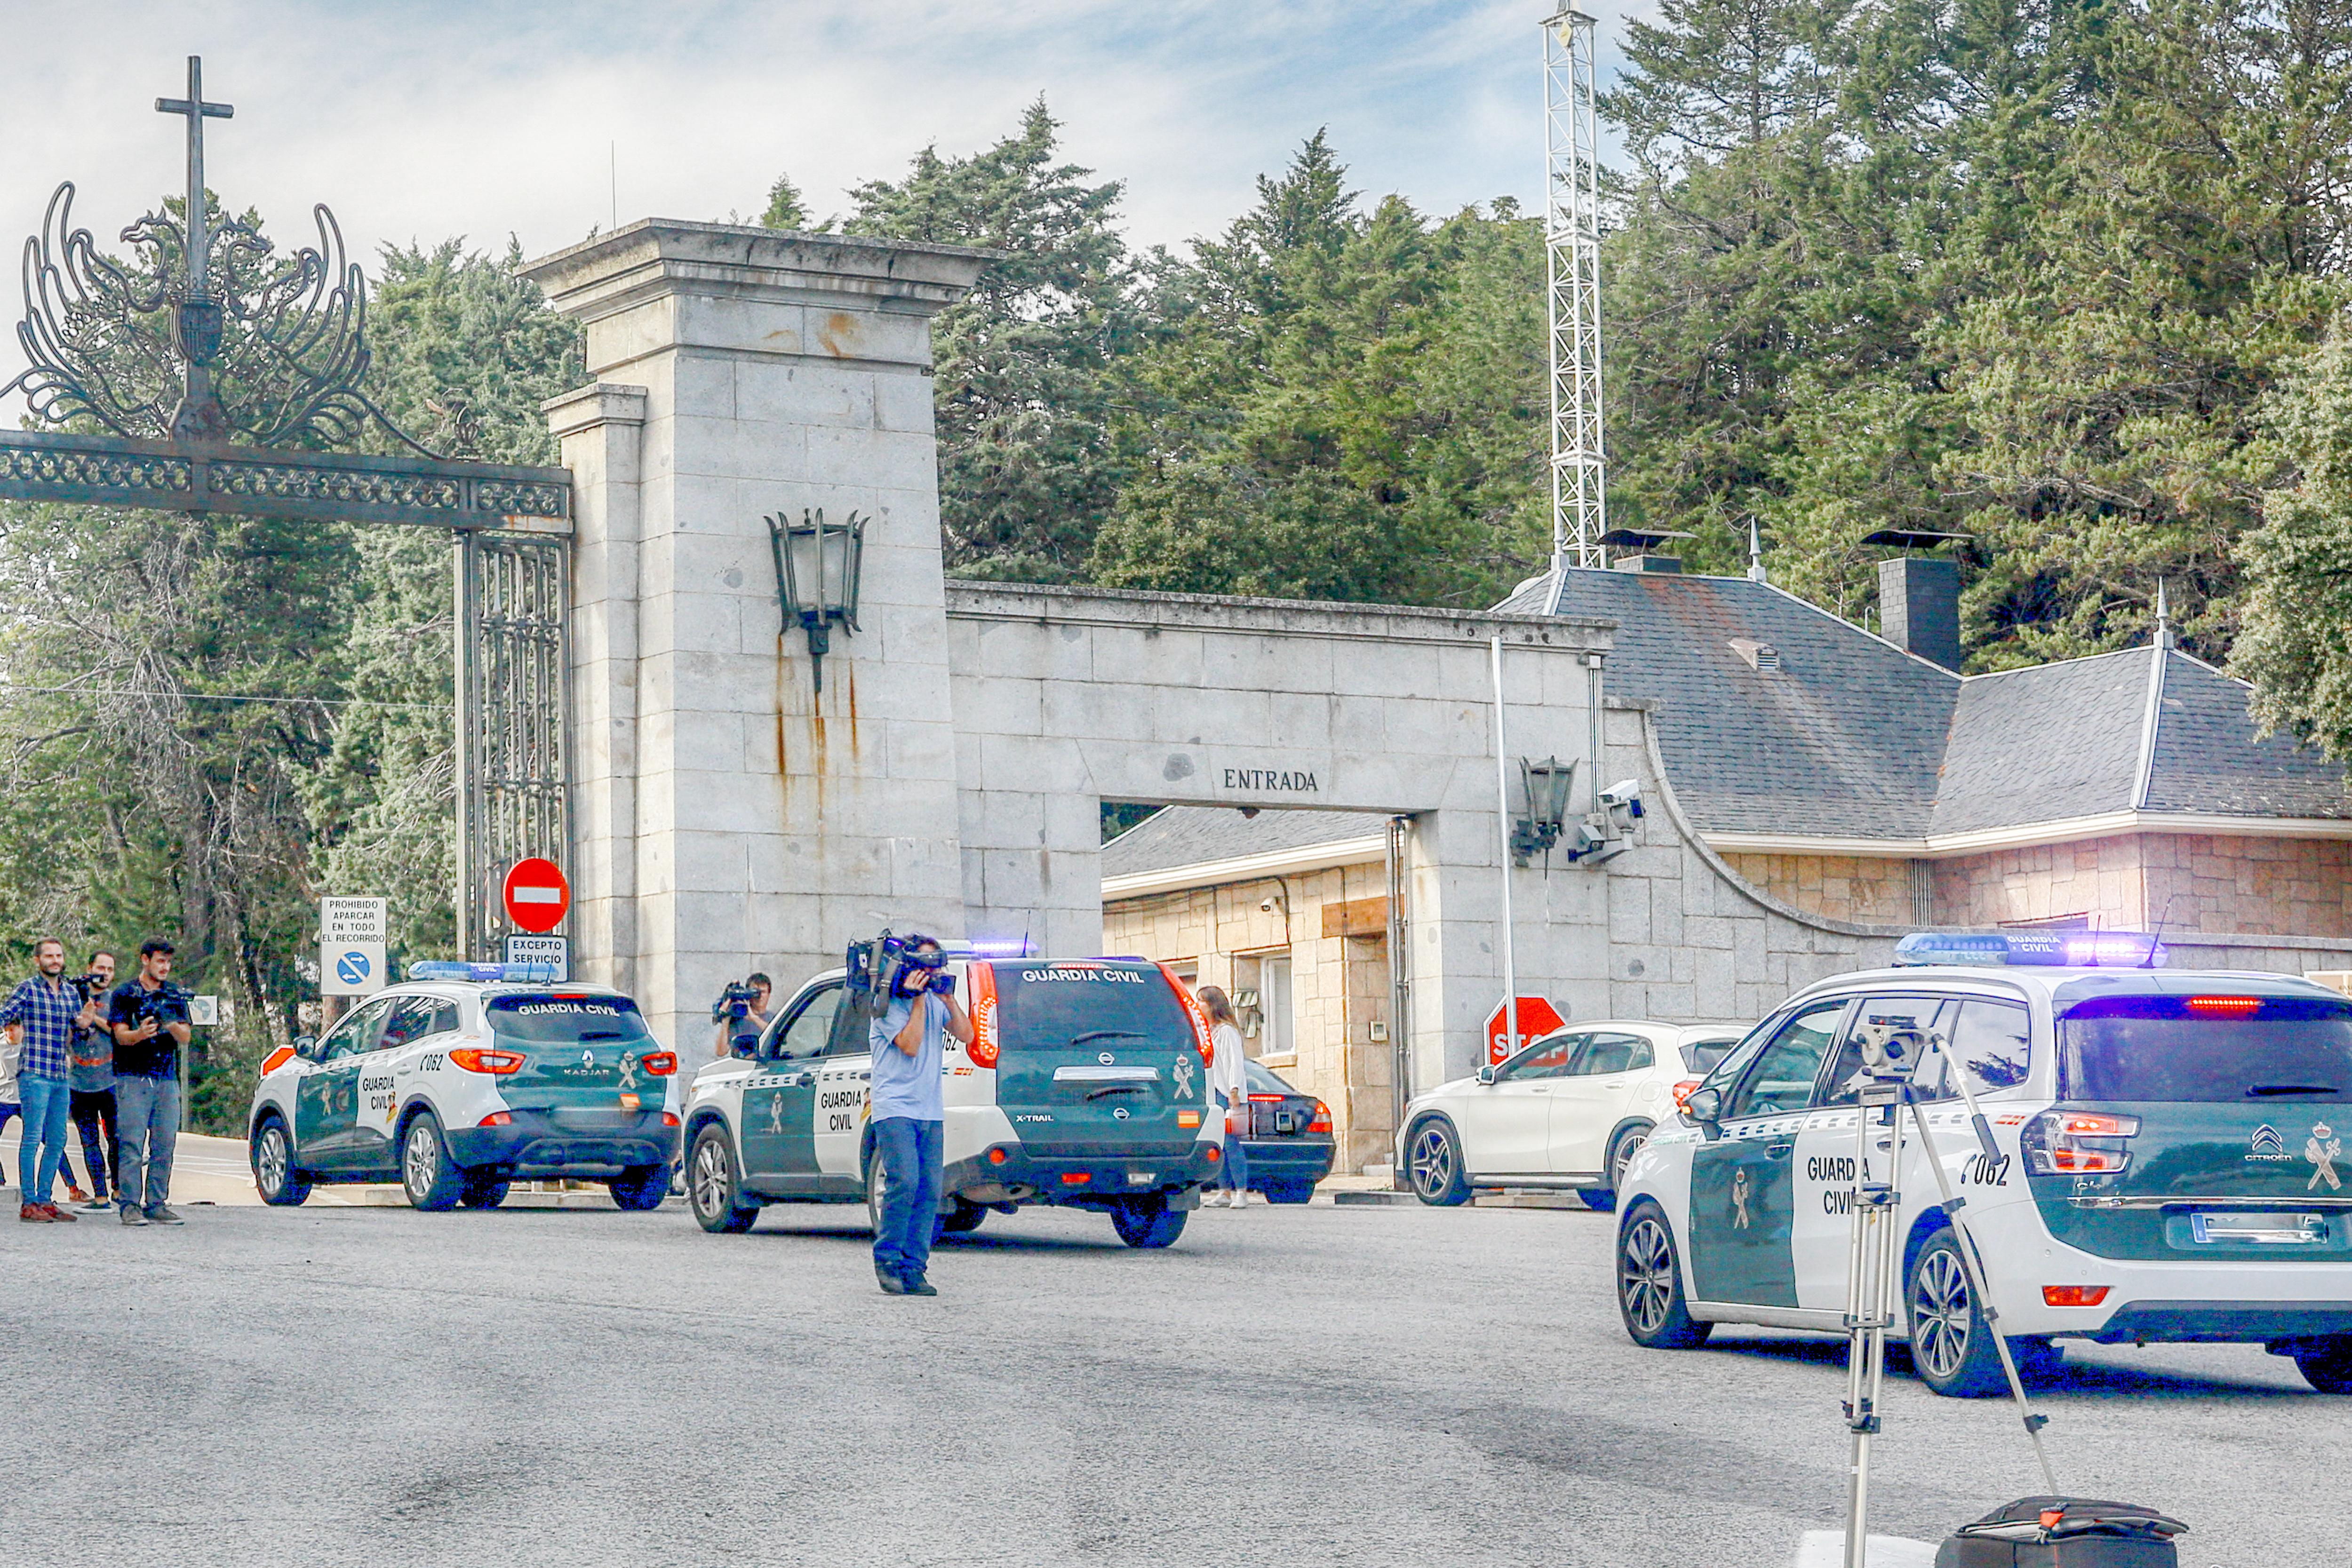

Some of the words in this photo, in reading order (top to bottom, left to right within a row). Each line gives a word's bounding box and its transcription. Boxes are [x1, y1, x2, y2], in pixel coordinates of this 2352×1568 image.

[1224, 769, 1318, 791] ENTRADA
[513, 941, 561, 950] EXCEPTO
[2022, 943, 2054, 952] CIVIL
[514, 954, 561, 963] SERVICIO
[1022, 970, 1100, 982] GUARDIA
[1102, 970, 1145, 984] CIVIL
[518, 1004, 584, 1016] GUARDIA
[585, 1004, 621, 1017] CIVIL
[1493, 1033, 1566, 1059] ST
[426, 1054, 443, 1071] 062
[363, 1076, 394, 1091] GUARDIA
[371, 1096, 388, 1110] CIVIL
[821, 1090, 861, 1109] GUARDIA
[829, 1114, 852, 1131] CIVIL
[1016, 1114, 1054, 1122] X-TRAIL
[1808, 1156, 1871, 1181] GUARDA
[1974, 1154, 2010, 1186] 062
